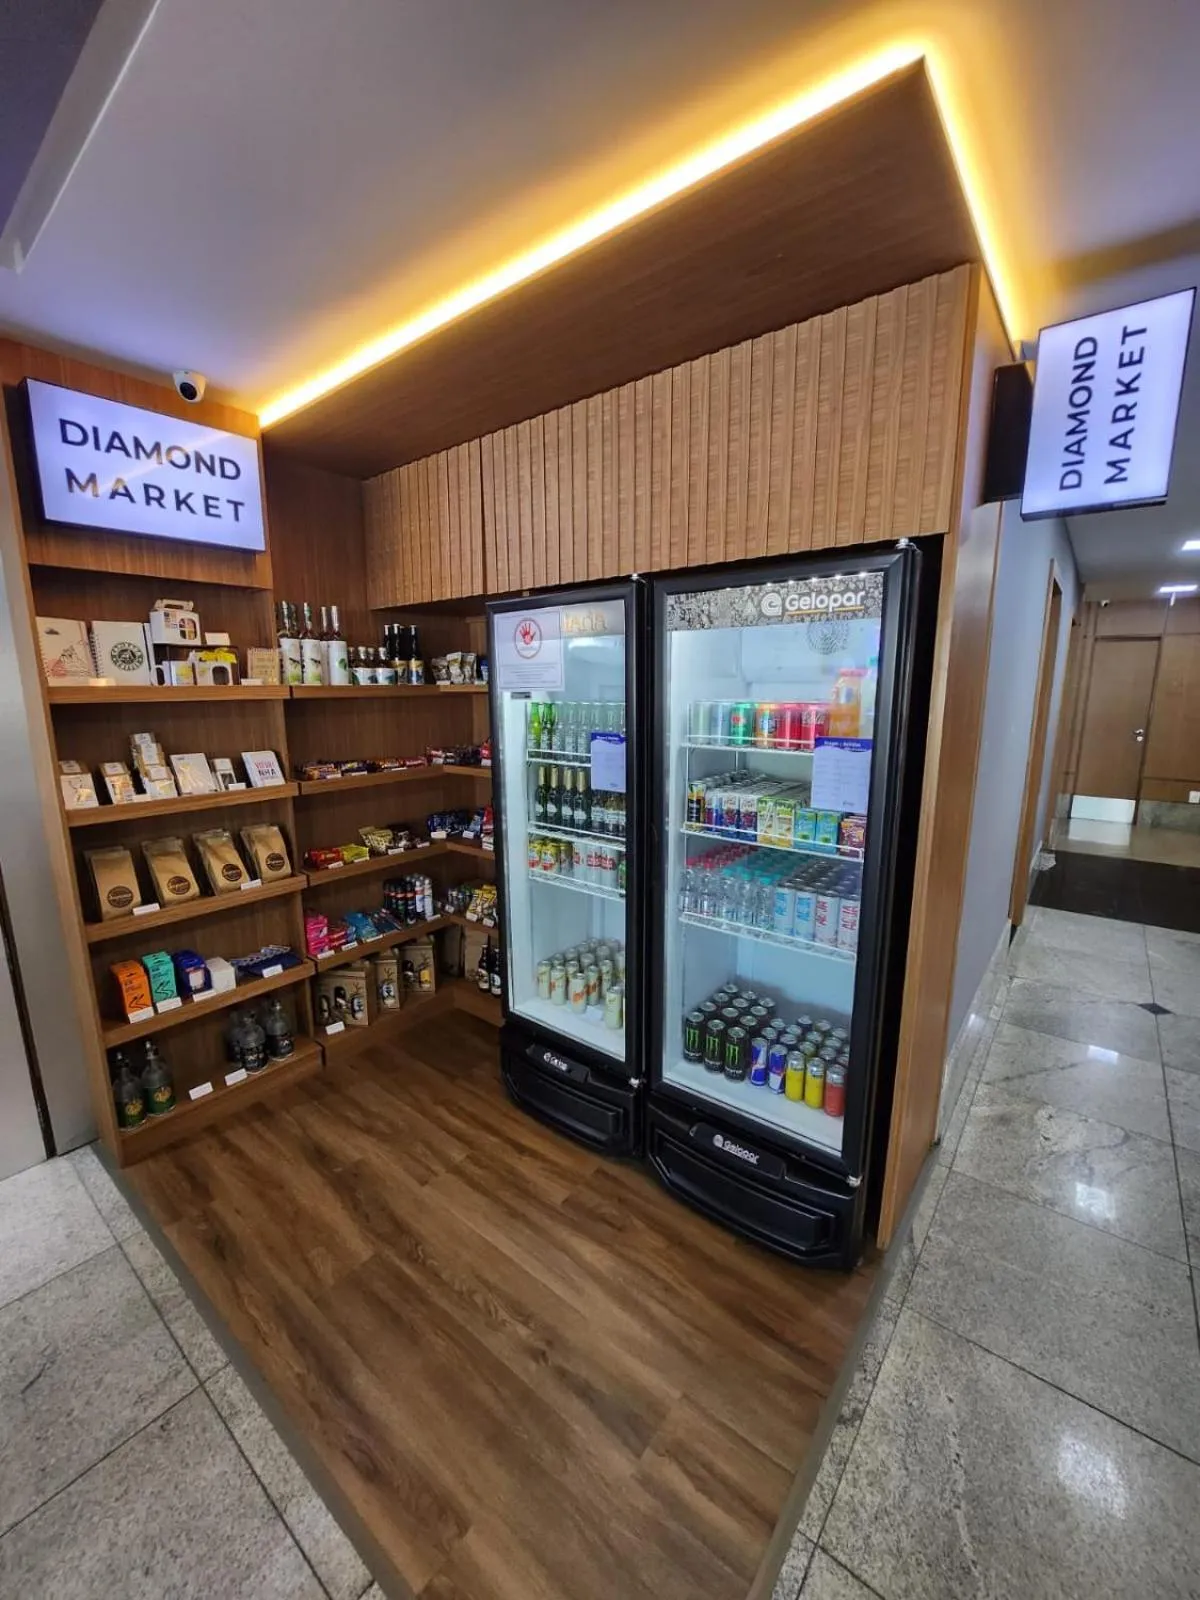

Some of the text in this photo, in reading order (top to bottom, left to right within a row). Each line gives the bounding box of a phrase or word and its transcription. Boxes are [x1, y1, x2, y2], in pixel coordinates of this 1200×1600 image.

[1059, 337, 1098, 490] DIAMOND
[1104, 326, 1148, 484] MARKET
[60, 419, 241, 481] DIAMOND
[66, 468, 245, 522] MARKET
[786, 591, 865, 612] Gelopar
